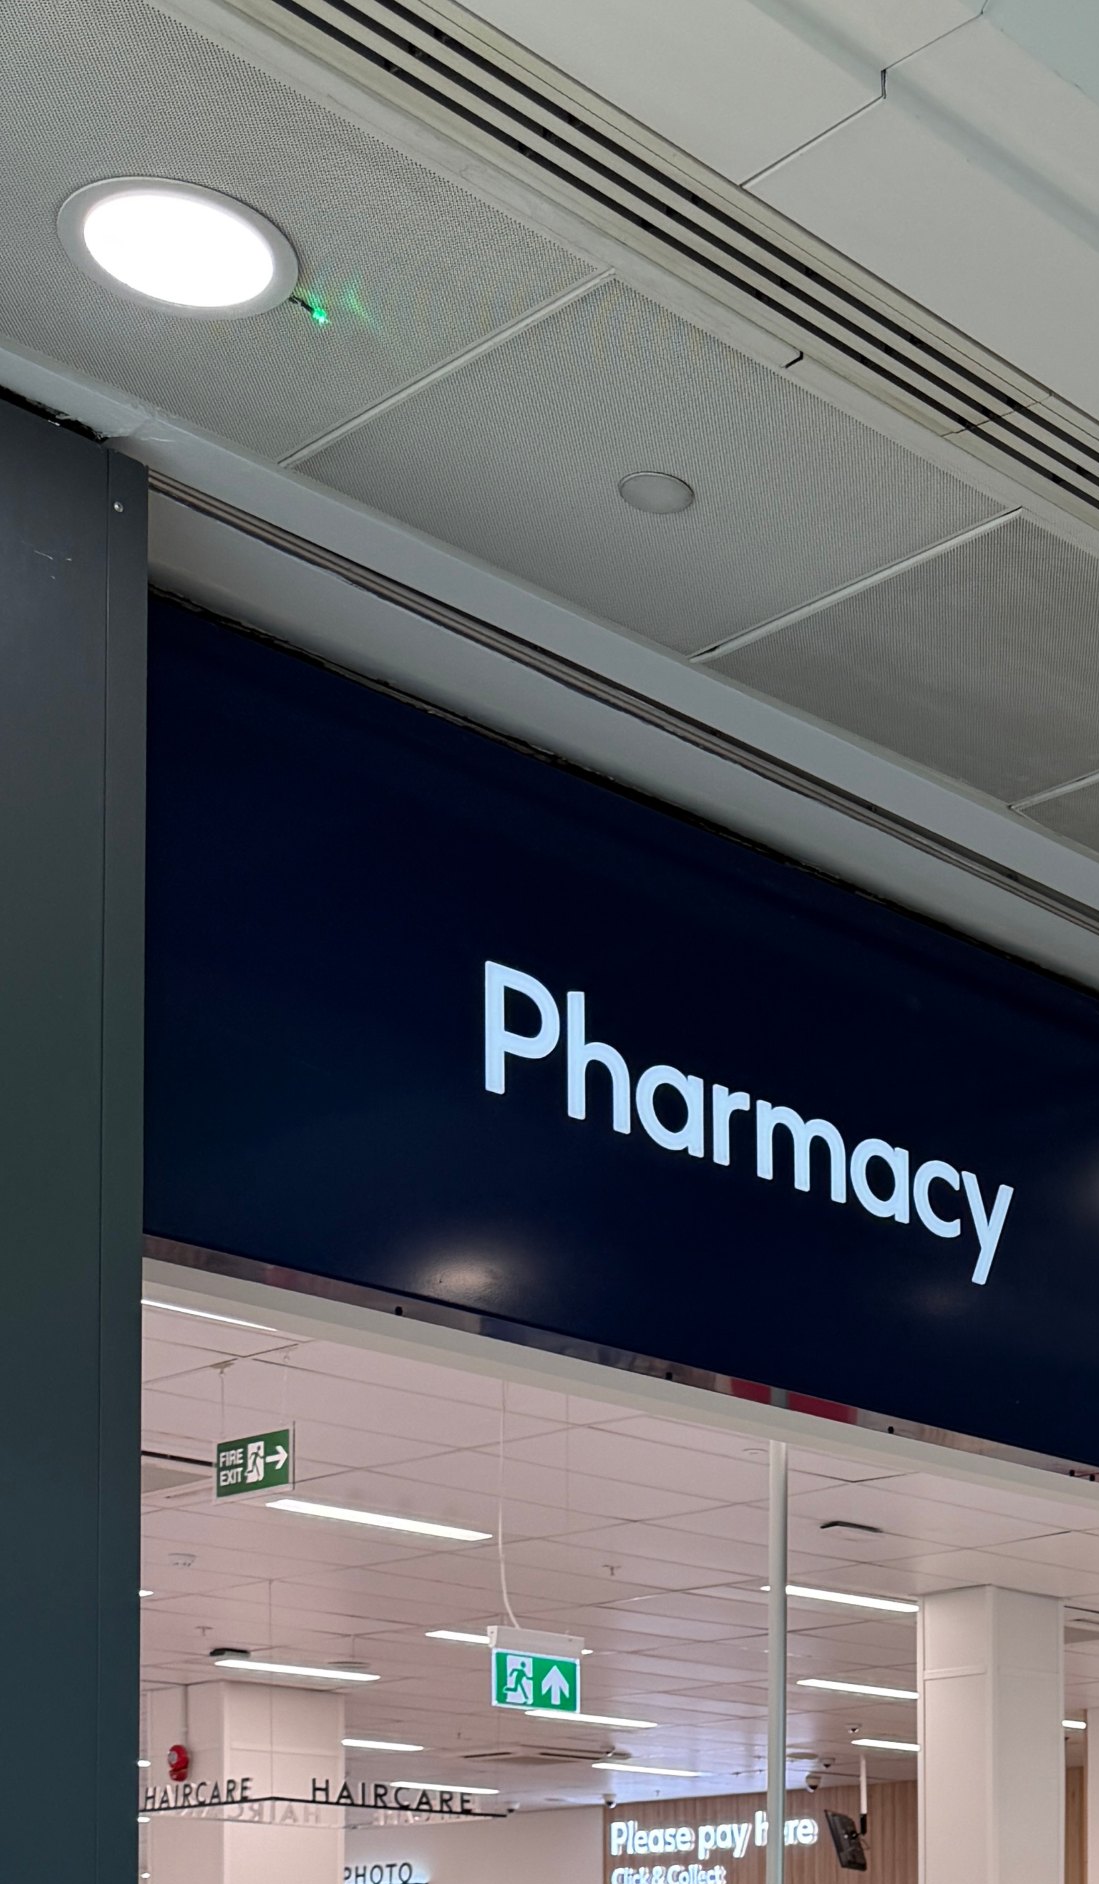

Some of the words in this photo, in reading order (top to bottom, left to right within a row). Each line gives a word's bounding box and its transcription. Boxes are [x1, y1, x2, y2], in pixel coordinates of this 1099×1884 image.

[485, 961, 1014, 1285] Pharmacy
[219, 1448, 244, 1467] FIRE
[219, 1467, 244, 1487] EXIT
[144, 1777, 253, 1809] HAIRCARE
[311, 1777, 474, 1813] HAIRCARE
[610, 1820, 695, 1856] Please
[697, 1822, 753, 1860] pay
[754, 1810, 819, 1847] hre
